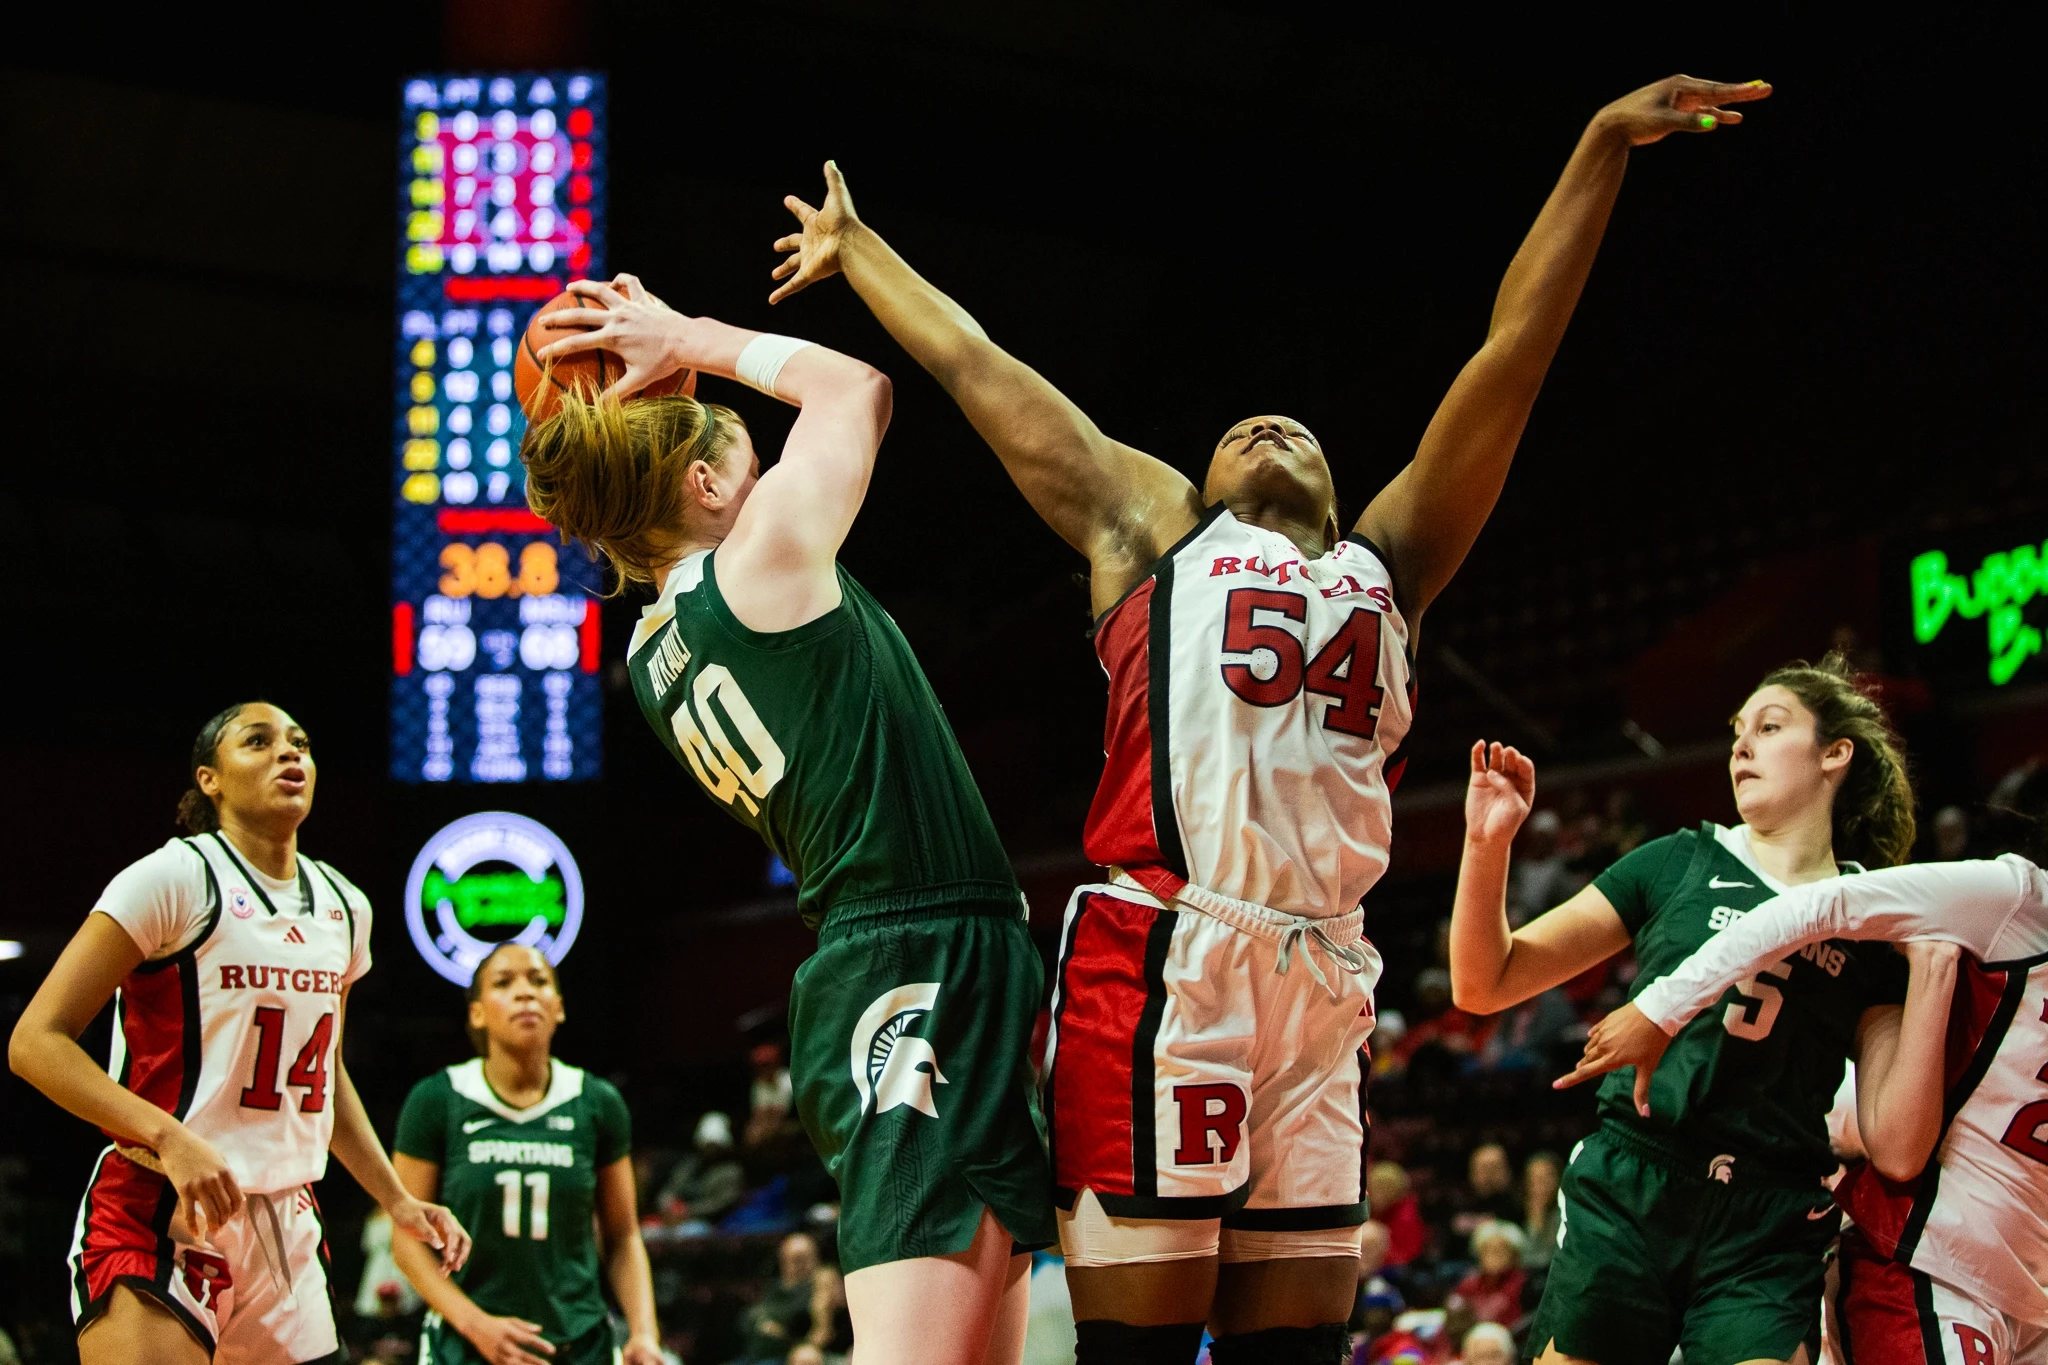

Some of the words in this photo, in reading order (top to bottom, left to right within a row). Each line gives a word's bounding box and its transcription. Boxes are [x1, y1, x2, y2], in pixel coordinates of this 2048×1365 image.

[1220, 587, 1385, 742] 54
[670, 662, 787, 818] 40
[1722, 959, 1793, 1042] 5
[239, 1005, 335, 1114] 14
[467, 1139, 575, 1169] SPARTANS
[1173, 1082, 1247, 1167] R
[494, 1169, 550, 1241] 11
